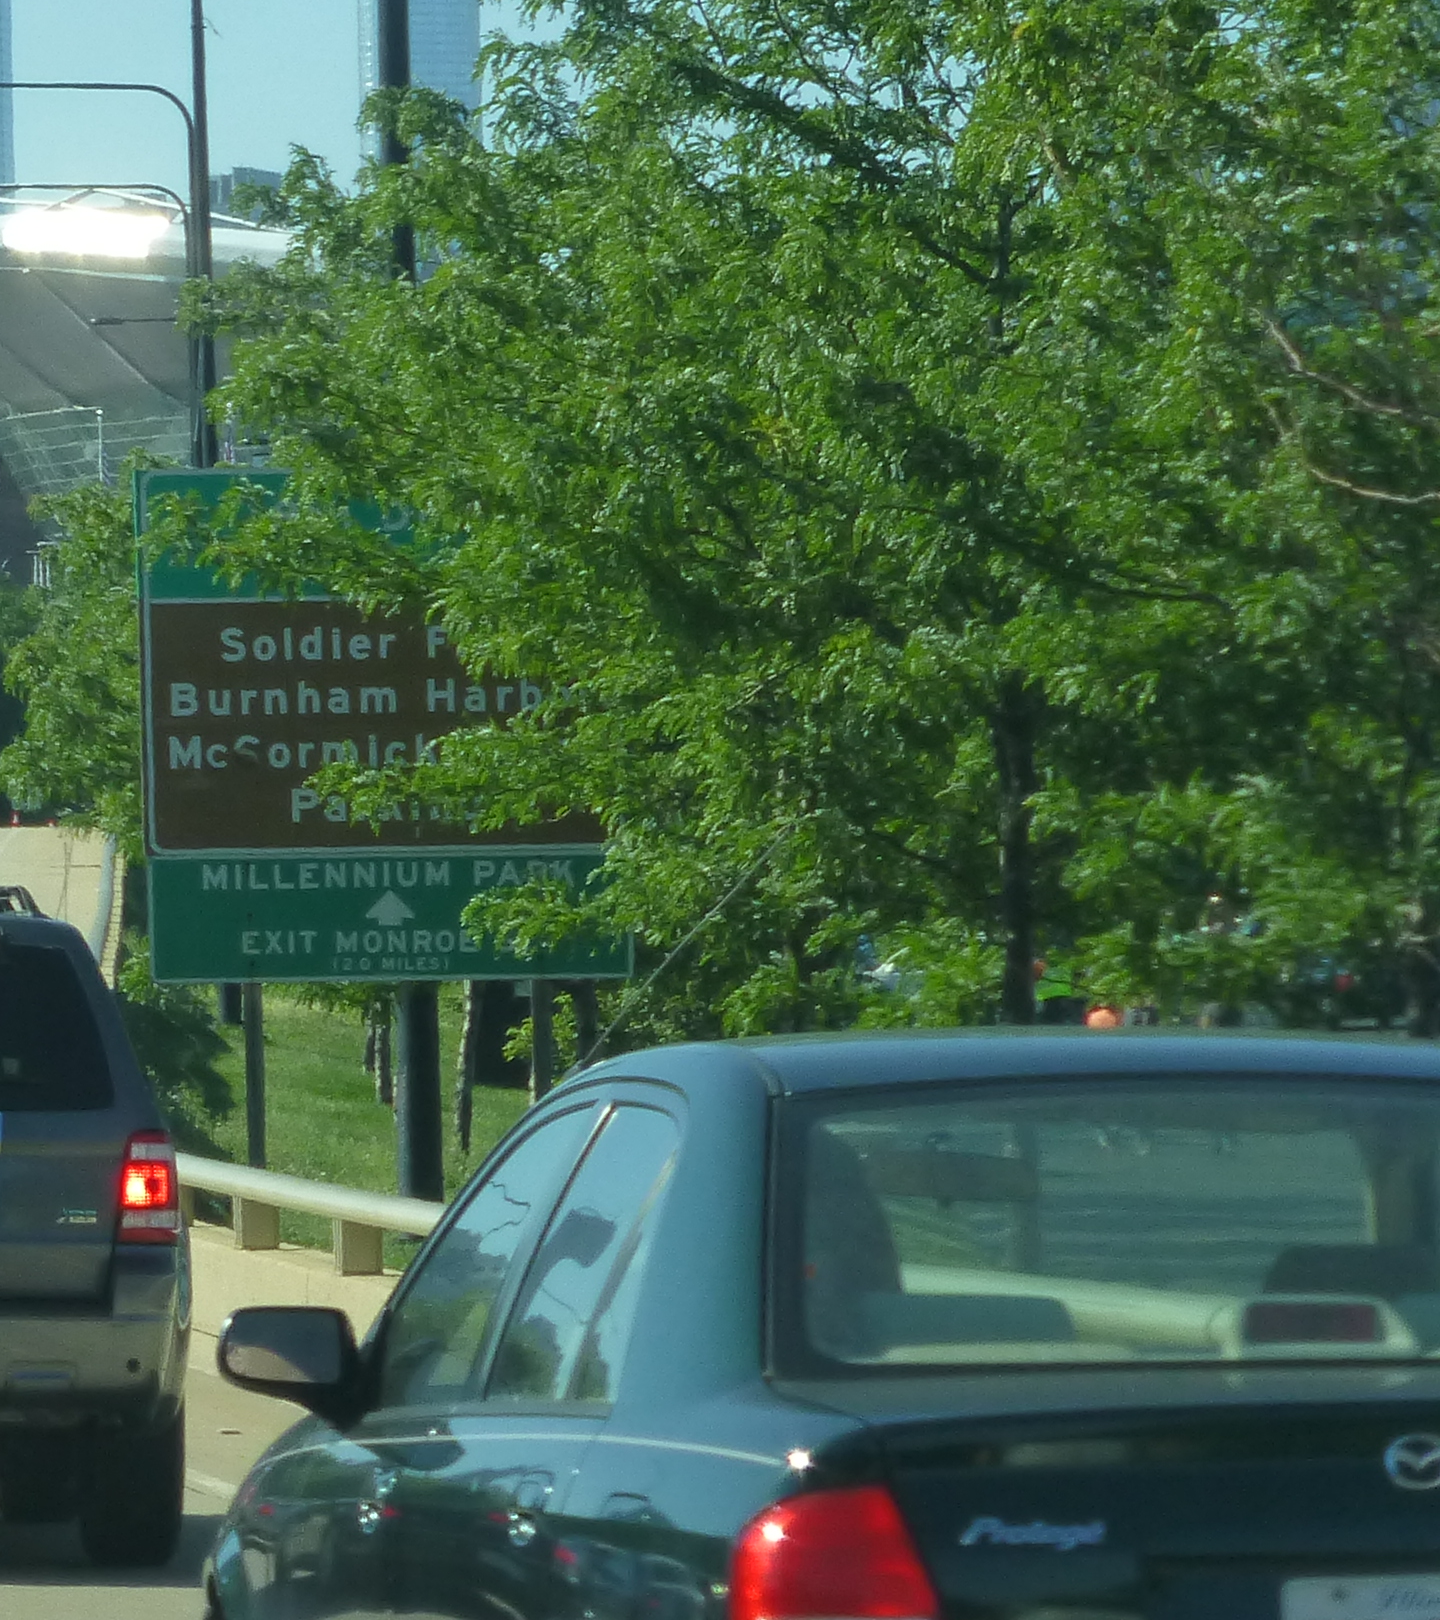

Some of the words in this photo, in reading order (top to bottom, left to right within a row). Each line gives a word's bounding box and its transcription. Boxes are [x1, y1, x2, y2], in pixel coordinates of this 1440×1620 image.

[220, 626, 396, 662] Soldier
[170, 680, 397, 717] Burnham
[202, 860, 450, 891] MILLENNIUM
[241, 930, 318, 955] EXIT
[336, 929, 479, 954] MONROE
